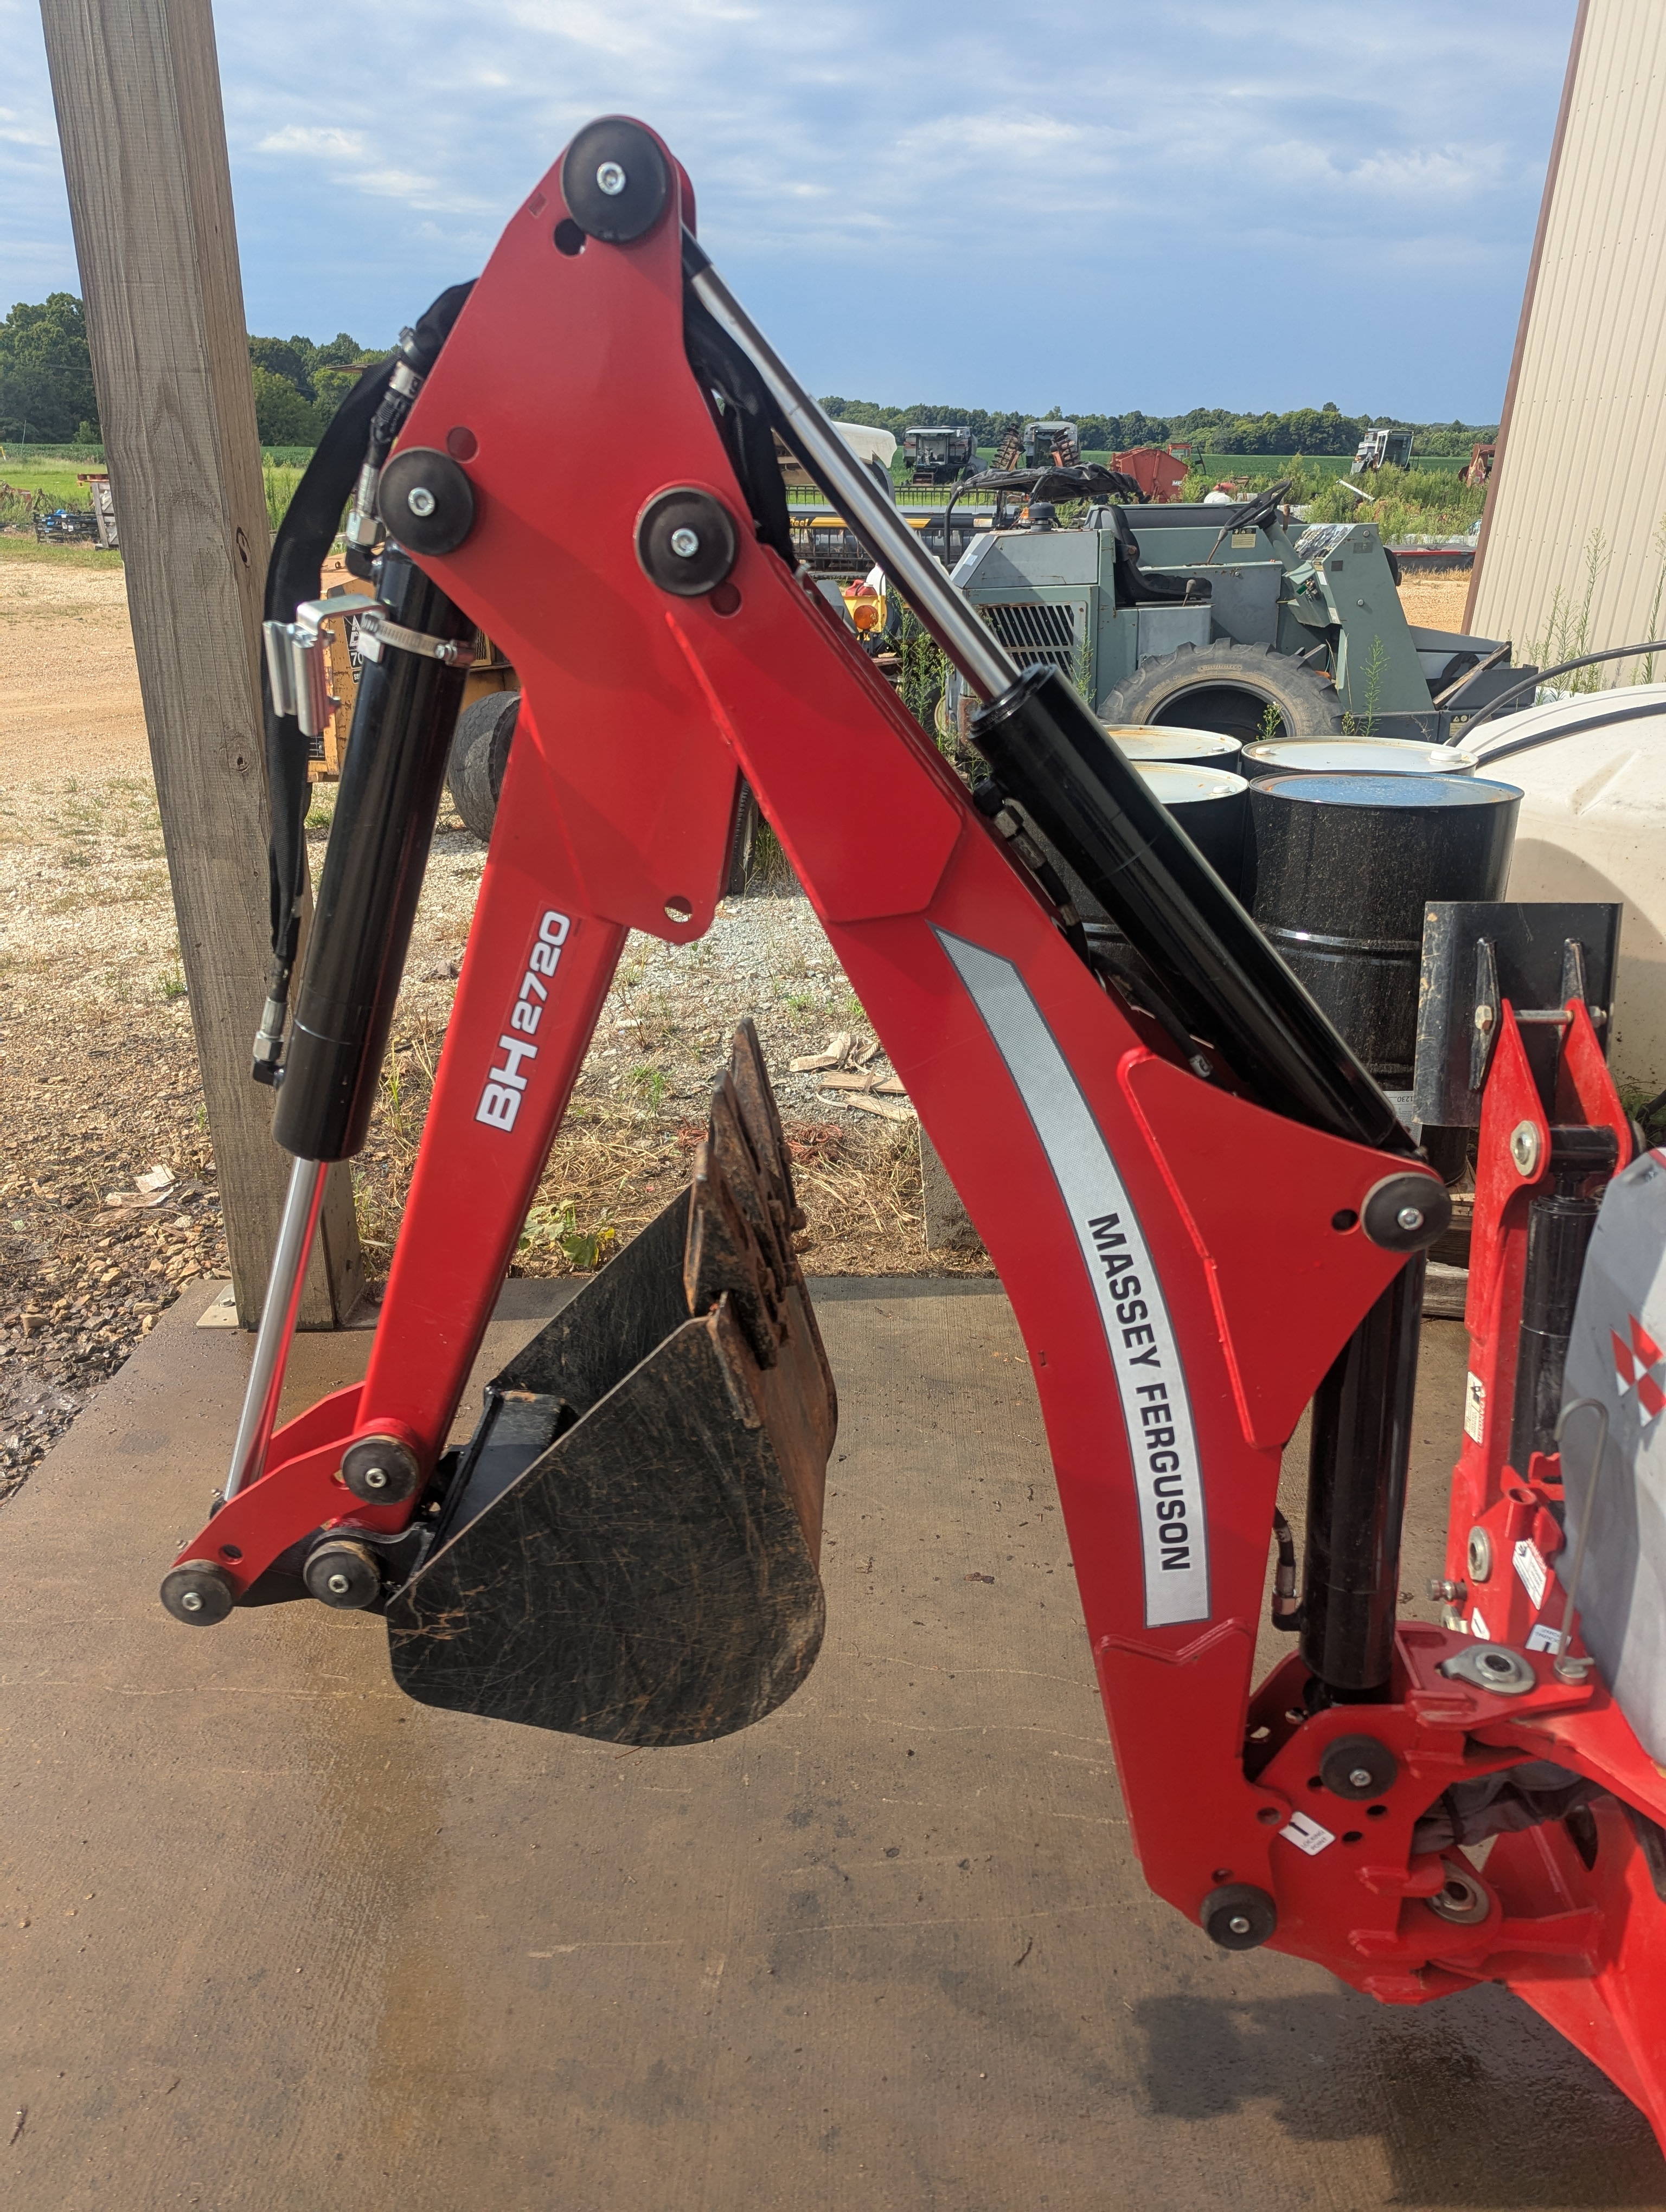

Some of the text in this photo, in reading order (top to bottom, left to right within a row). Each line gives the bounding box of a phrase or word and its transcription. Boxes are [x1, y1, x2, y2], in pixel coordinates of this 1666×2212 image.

[790, 518, 809, 526] Reel
[475, 910, 571, 1133] BH 2720
[1087, 1213, 1191, 1572] MASSEY FERGUSON
